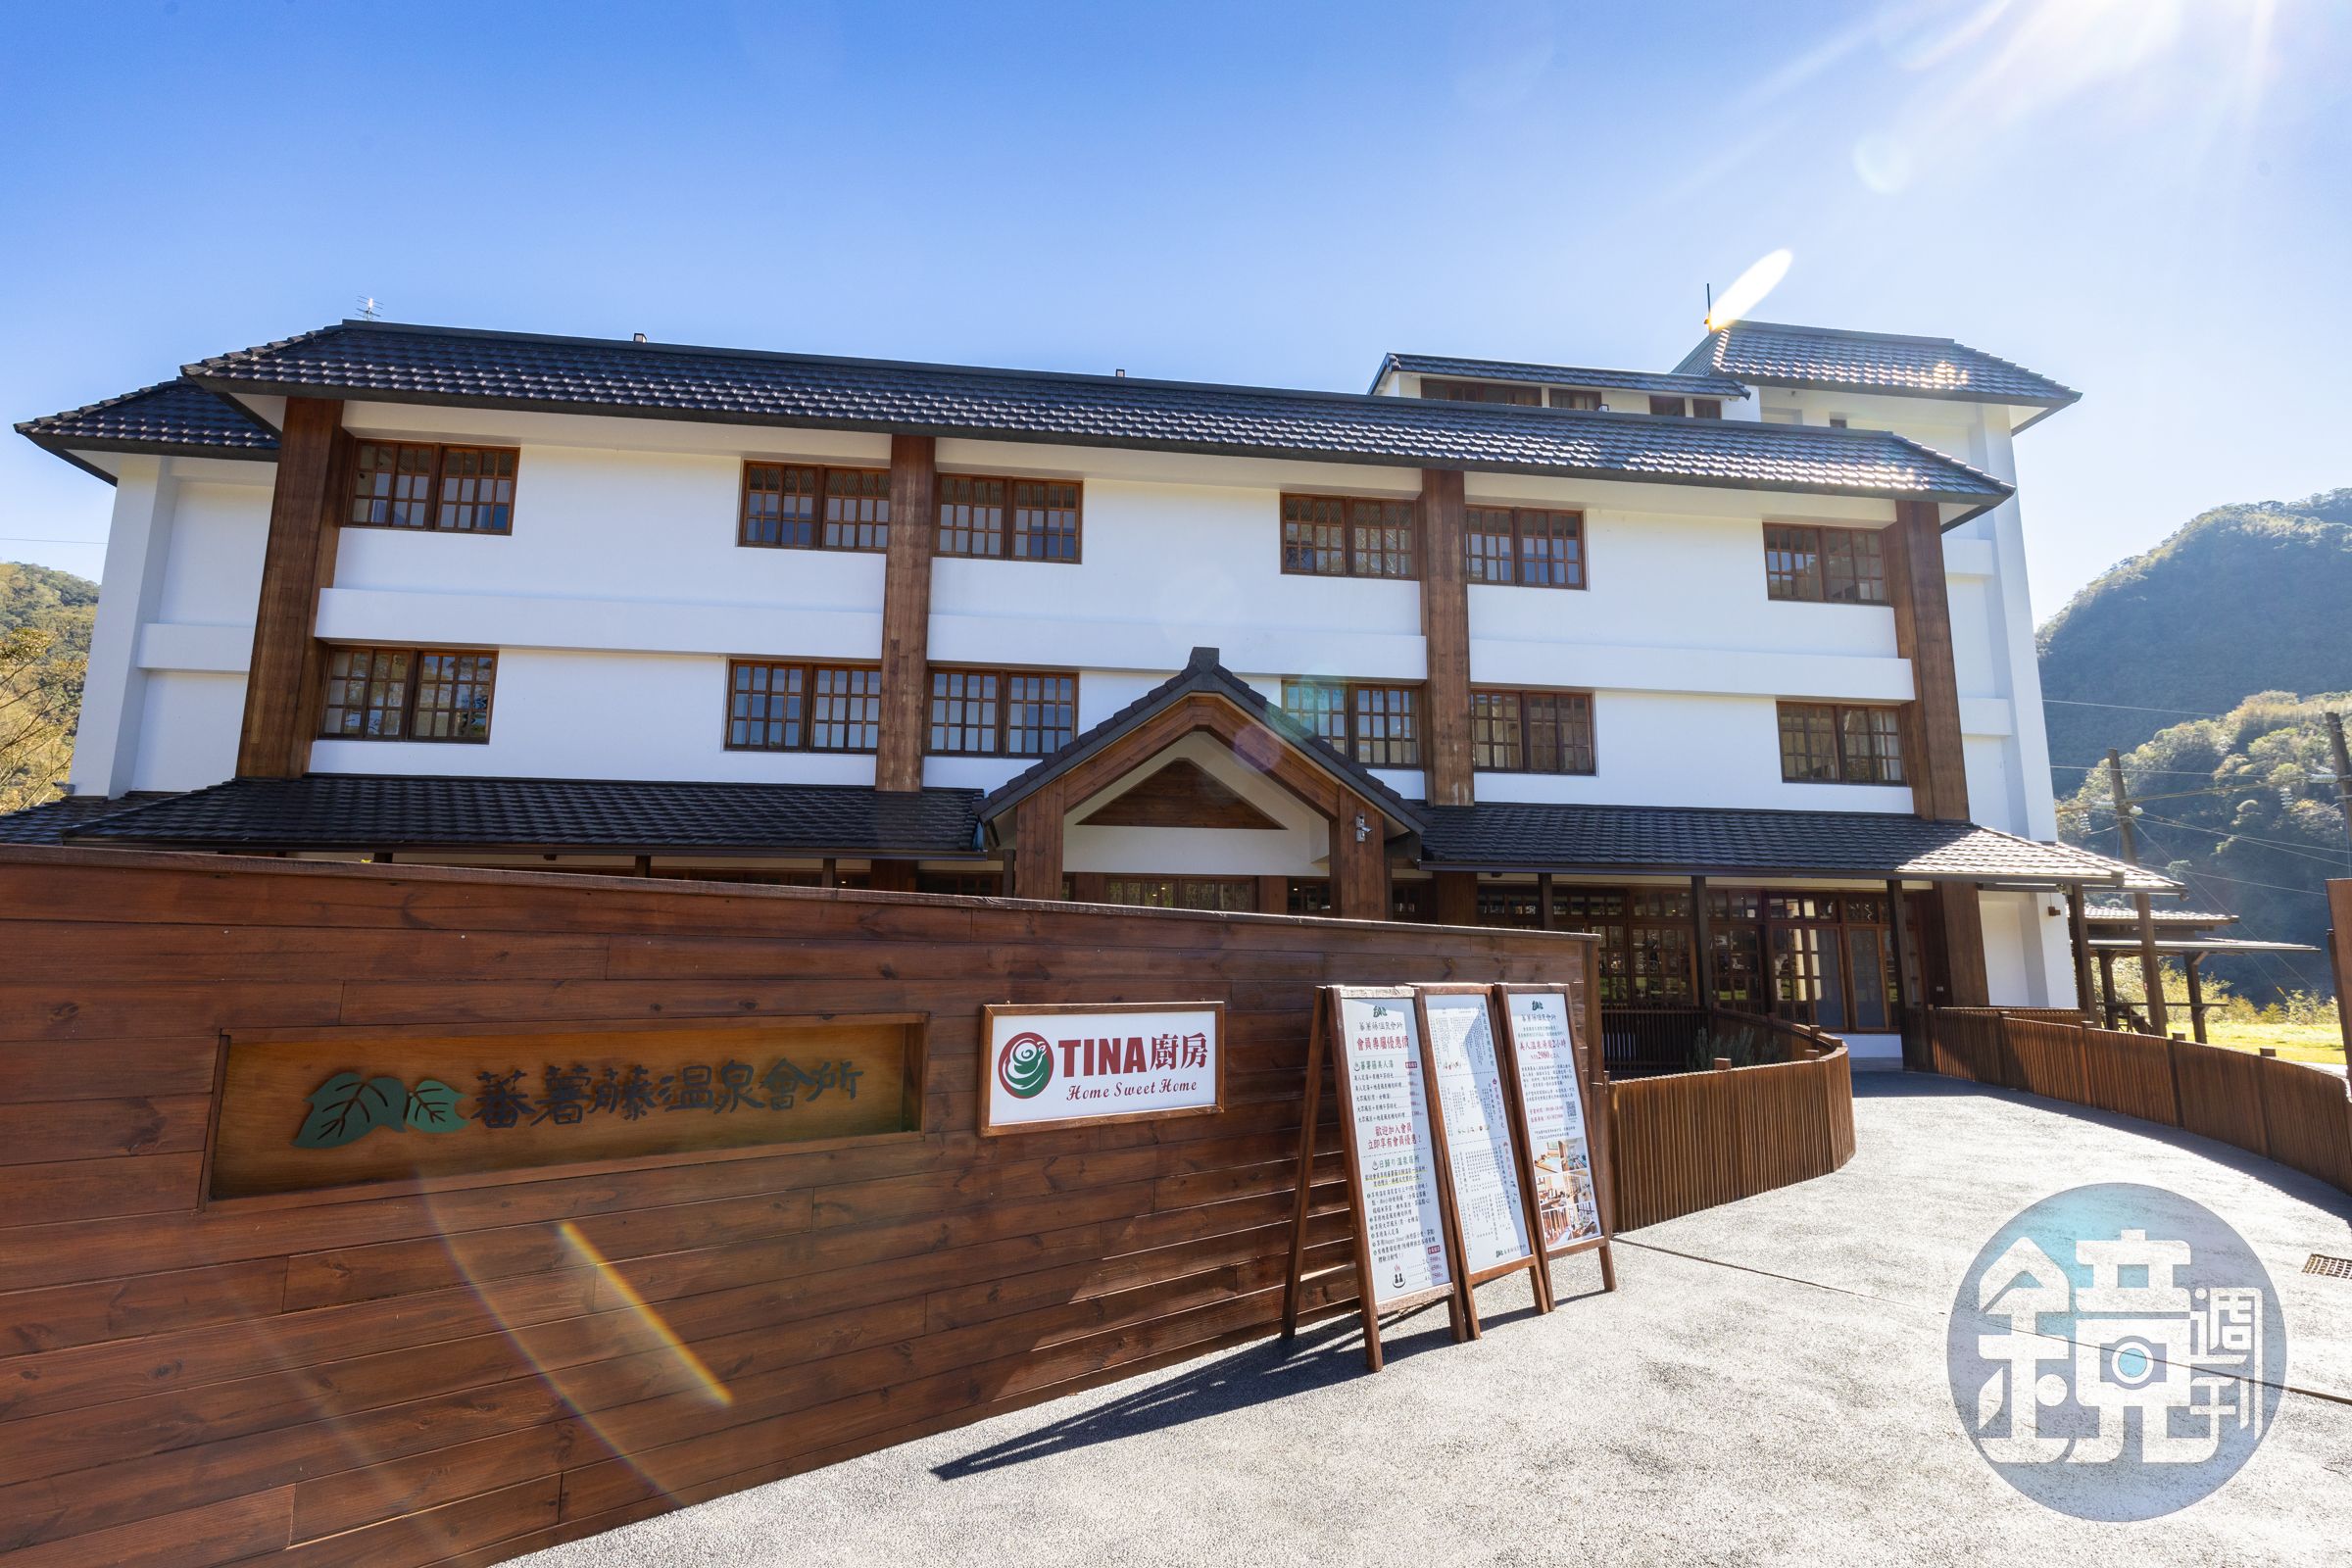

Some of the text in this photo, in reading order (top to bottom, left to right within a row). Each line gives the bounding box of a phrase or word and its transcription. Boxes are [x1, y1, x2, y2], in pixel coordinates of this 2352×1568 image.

[1058, 1032, 1207, 1077] TINA廚房
[1066, 1078, 1198, 1102] Home Sweet Home
